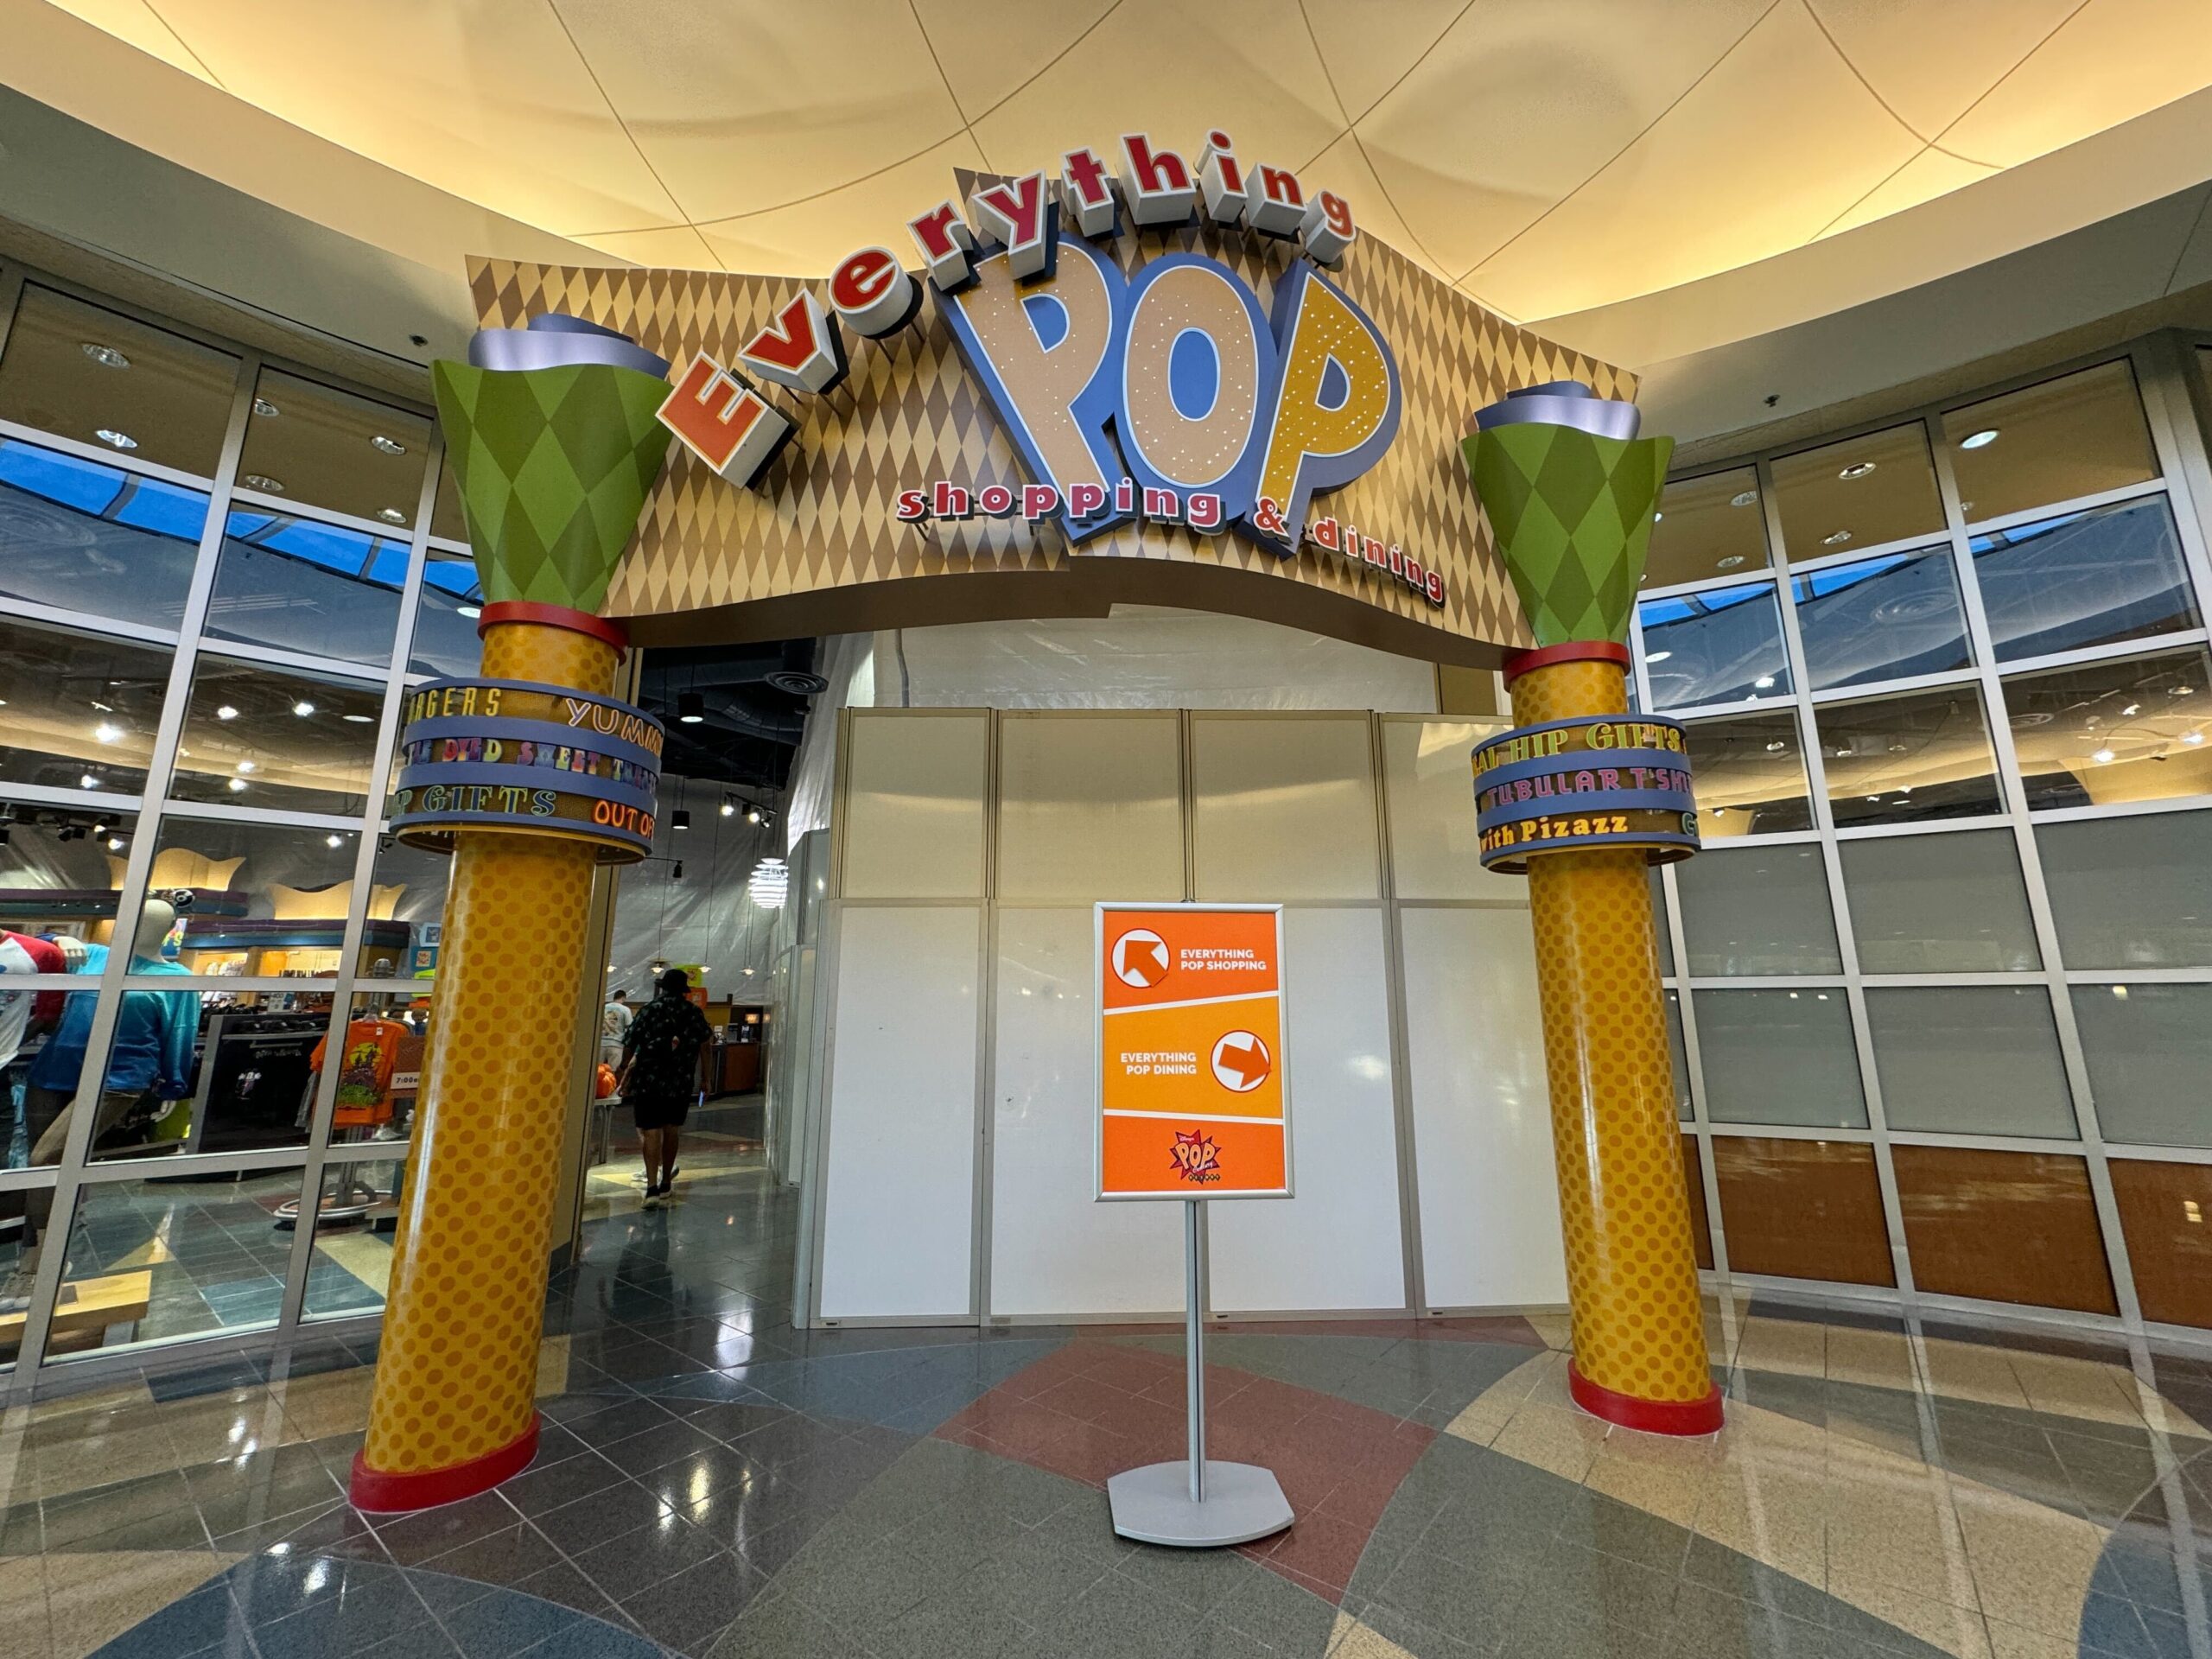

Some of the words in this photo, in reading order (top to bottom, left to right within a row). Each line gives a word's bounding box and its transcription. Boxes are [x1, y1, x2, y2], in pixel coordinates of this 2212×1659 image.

[657, 129, 1356, 487] Everything
[949, 235, 1400, 537] POP
[897, 479, 1224, 532] shopping
[1254, 496, 1290, 540] &
[1313, 516, 1446, 607] dining
[407, 687, 502, 726] RGERS
[1510, 729, 1568, 763] HIP
[1586, 722, 1681, 752] GIFTS
[422, 785, 557, 817] GIFTS
[1487, 768, 1621, 808] TUBULAR
[594, 800, 639, 831] OUT
[1480, 825, 1515, 854] with
[1521, 816, 1628, 842] Pizazz
[1180, 949, 1254, 960] EVERYTHING
[1180, 961, 1205, 970] POP
[1206, 961, 1267, 970] SHOPPING
[1120, 1052, 1197, 1063] EVERYTHING
[1126, 1065, 1151, 1075] POP
[1153, 1065, 1197, 1075] DINING
[1175, 1142, 1216, 1170] POP
